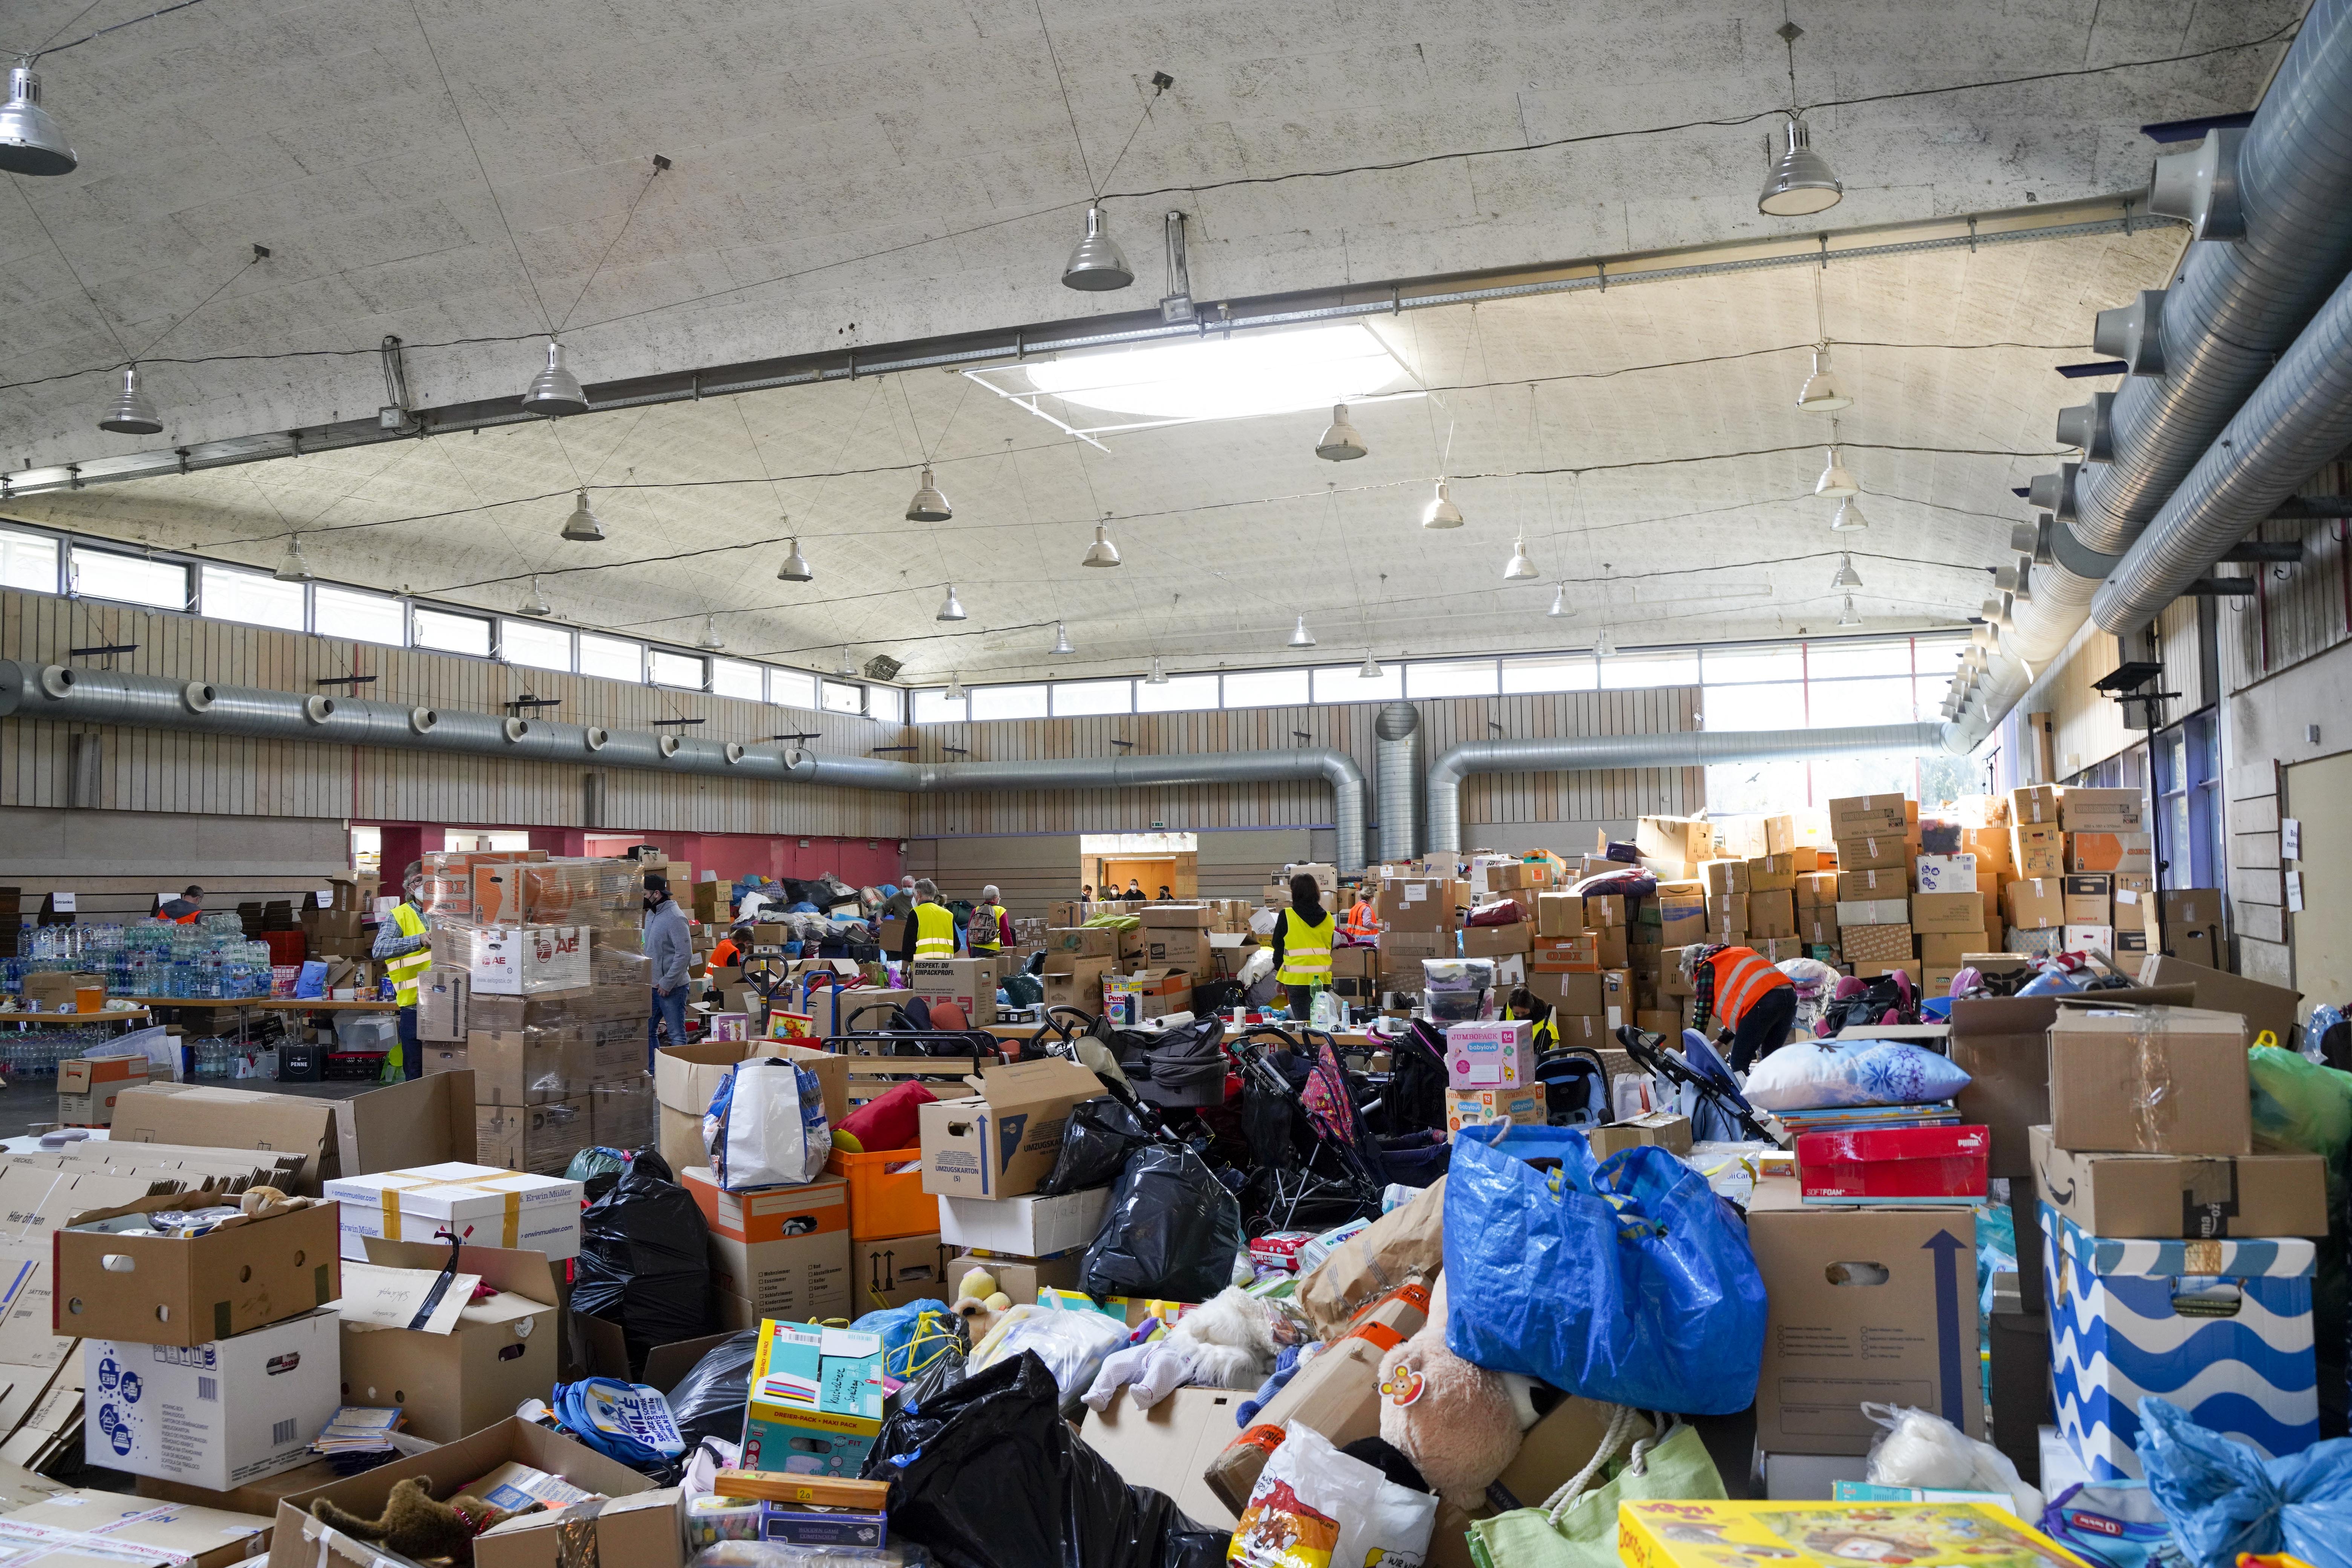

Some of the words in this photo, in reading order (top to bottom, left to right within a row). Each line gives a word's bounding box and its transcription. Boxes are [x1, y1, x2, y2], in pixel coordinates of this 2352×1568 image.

[424, 880, 466, 894] OBI
[1546, 952, 1582, 961] OBI
[1051, 993, 1066, 1001] Marlboro
[1504, 1089, 1534, 1100] JUMBOPACK
[1511, 1102, 1534, 1111] babylove
[1024, 1138, 1065, 1153] UMZUGSKAR
[1957, 1139, 1980, 1147] PUMA
[935, 1165, 979, 1175] UMZUGSKARTON
[334, 1190, 377, 1203] erwinmueller.com
[525, 1192, 548, 1202] Erwin
[548, 1188, 573, 1200] Müller
[7, 1211, 21, 1223] Hier
[22, 1212, 45, 1226] öffnen
[340, 1223, 358, 1233] Erwin
[358, 1225, 379, 1237] Müller
[524, 1225, 573, 1239] erwinmueller.com
[813, 1267, 842, 1276] Abstellkammer
[1401, 1287, 1429, 1304] Glas!
[624, 1397, 655, 1444] SMILE
[774, 1411, 817, 1423] DREIER-PACK
[1254, 1428, 1282, 1445] Vorsic
[799, 1490, 811, 1499] 2a
[1387, 1556, 1404, 1567] WIR
